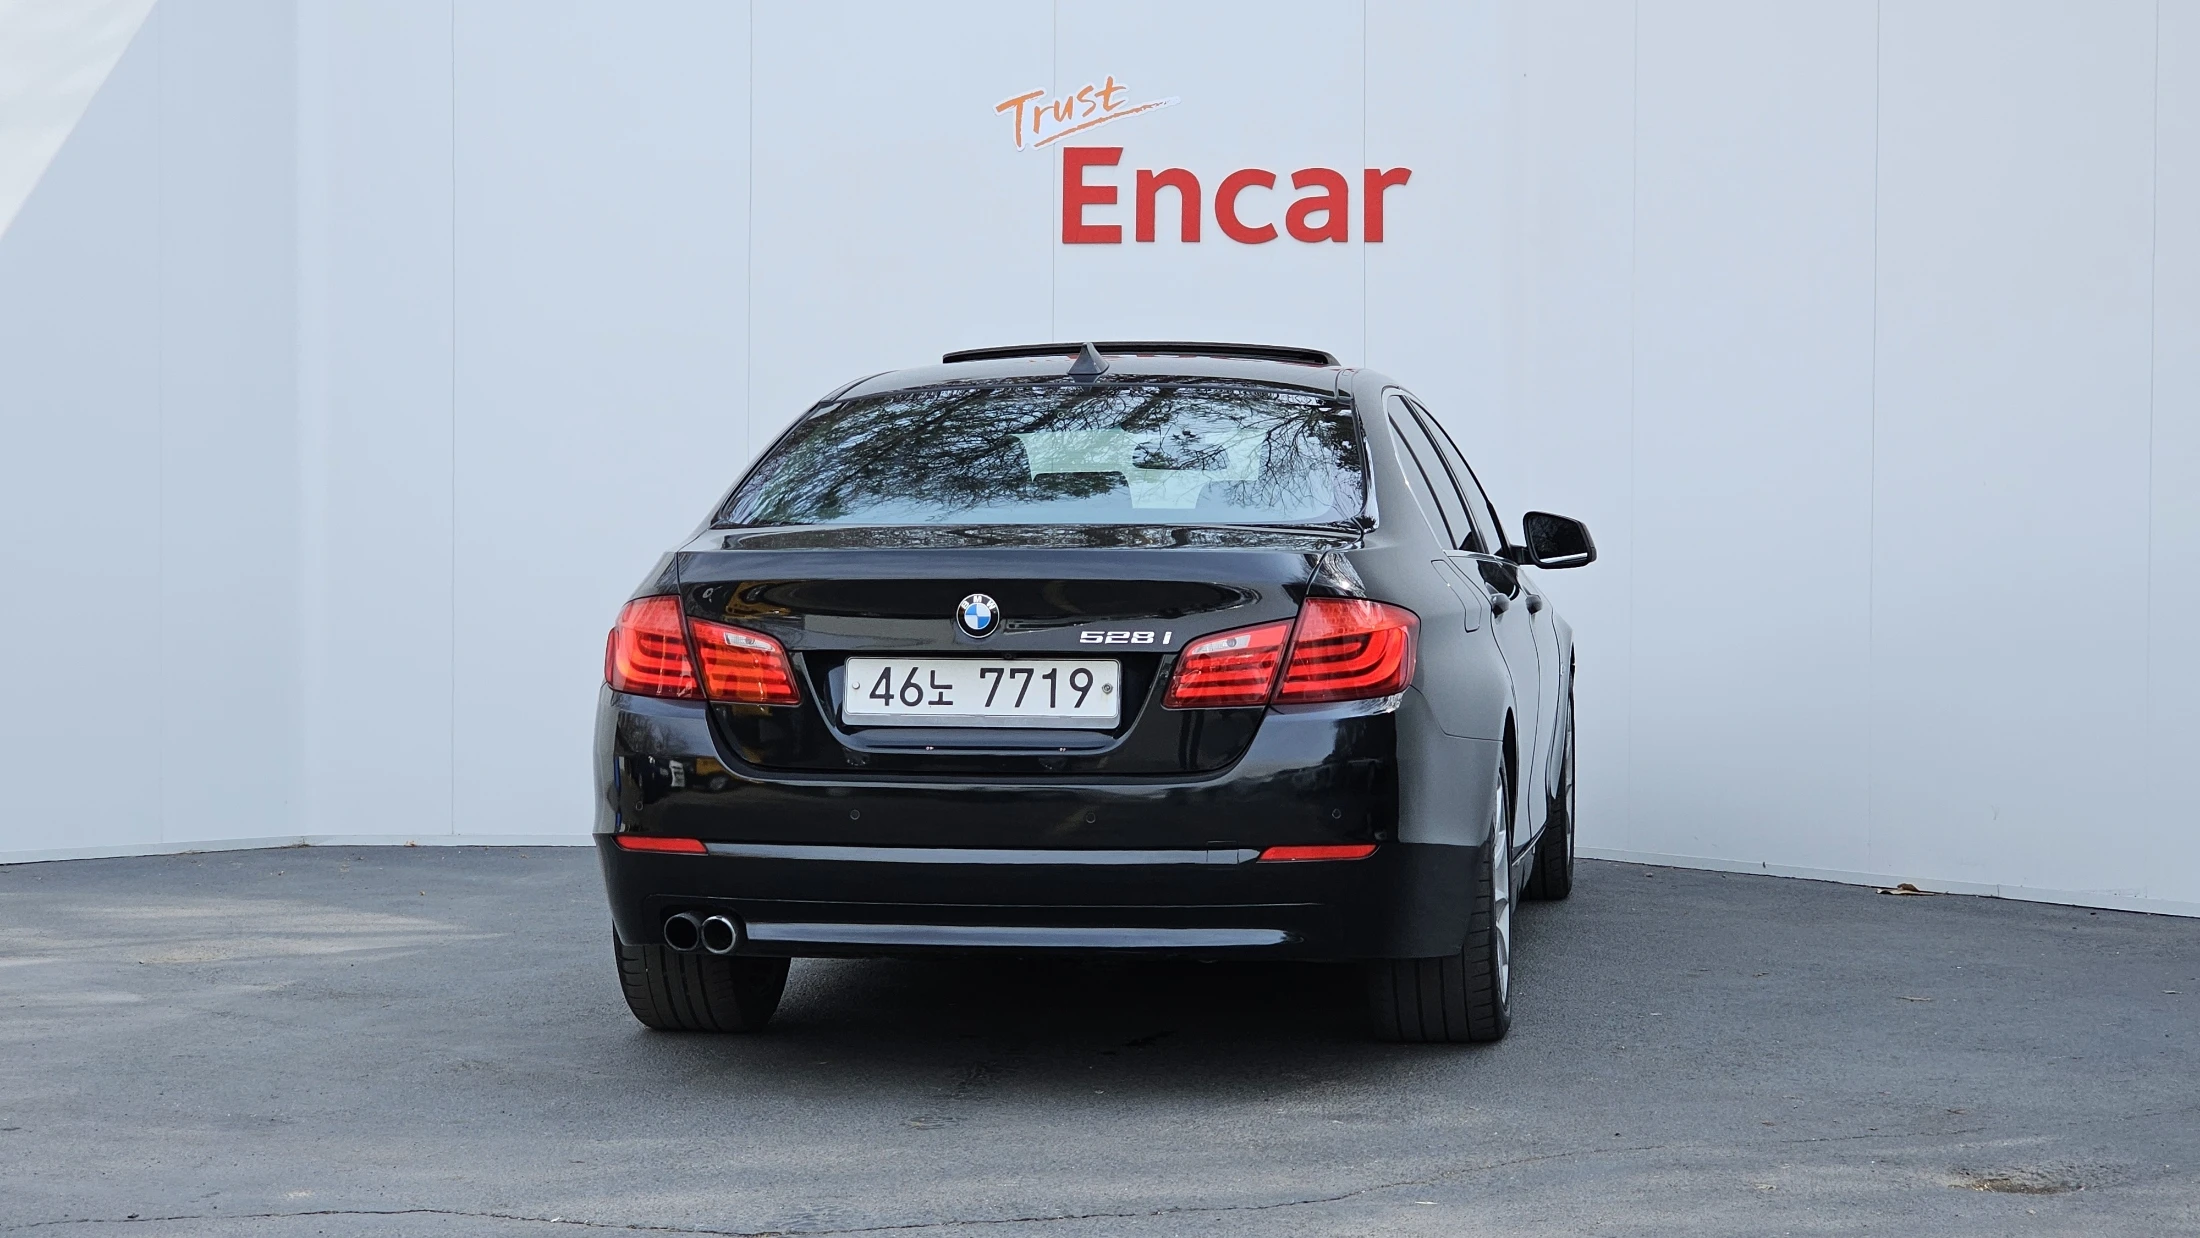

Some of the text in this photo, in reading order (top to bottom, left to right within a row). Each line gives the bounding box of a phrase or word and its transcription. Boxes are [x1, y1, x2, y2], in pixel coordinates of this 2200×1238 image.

[996, 76, 1127, 147] Trust
[1062, 147, 1412, 244] Encar
[960, 595, 997, 610] BMW
[869, 666, 1094, 709] 46노 7719
